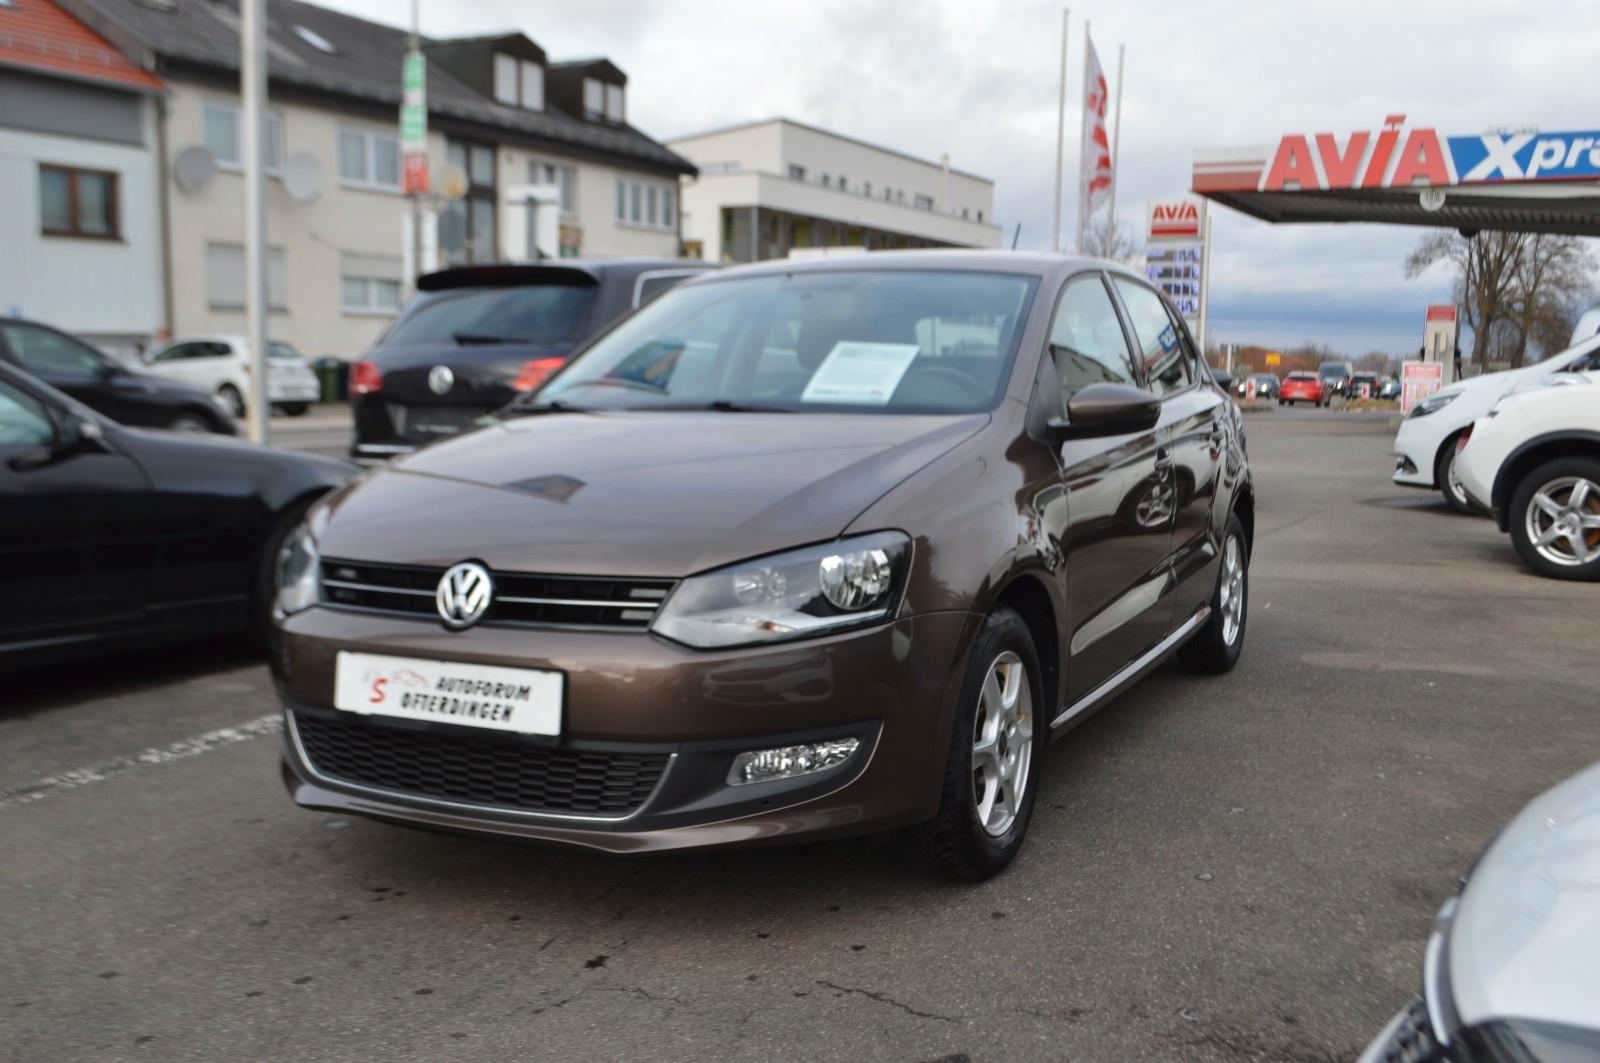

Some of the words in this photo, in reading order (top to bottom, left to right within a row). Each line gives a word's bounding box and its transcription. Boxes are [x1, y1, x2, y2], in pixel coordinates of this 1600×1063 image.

[1260, 114, 1455, 190] AVIA
[1152, 201, 1198, 220] AVIA
[437, 677, 531, 701] AUTOFORUM
[401, 693, 514, 722] OFTERDINGEN
